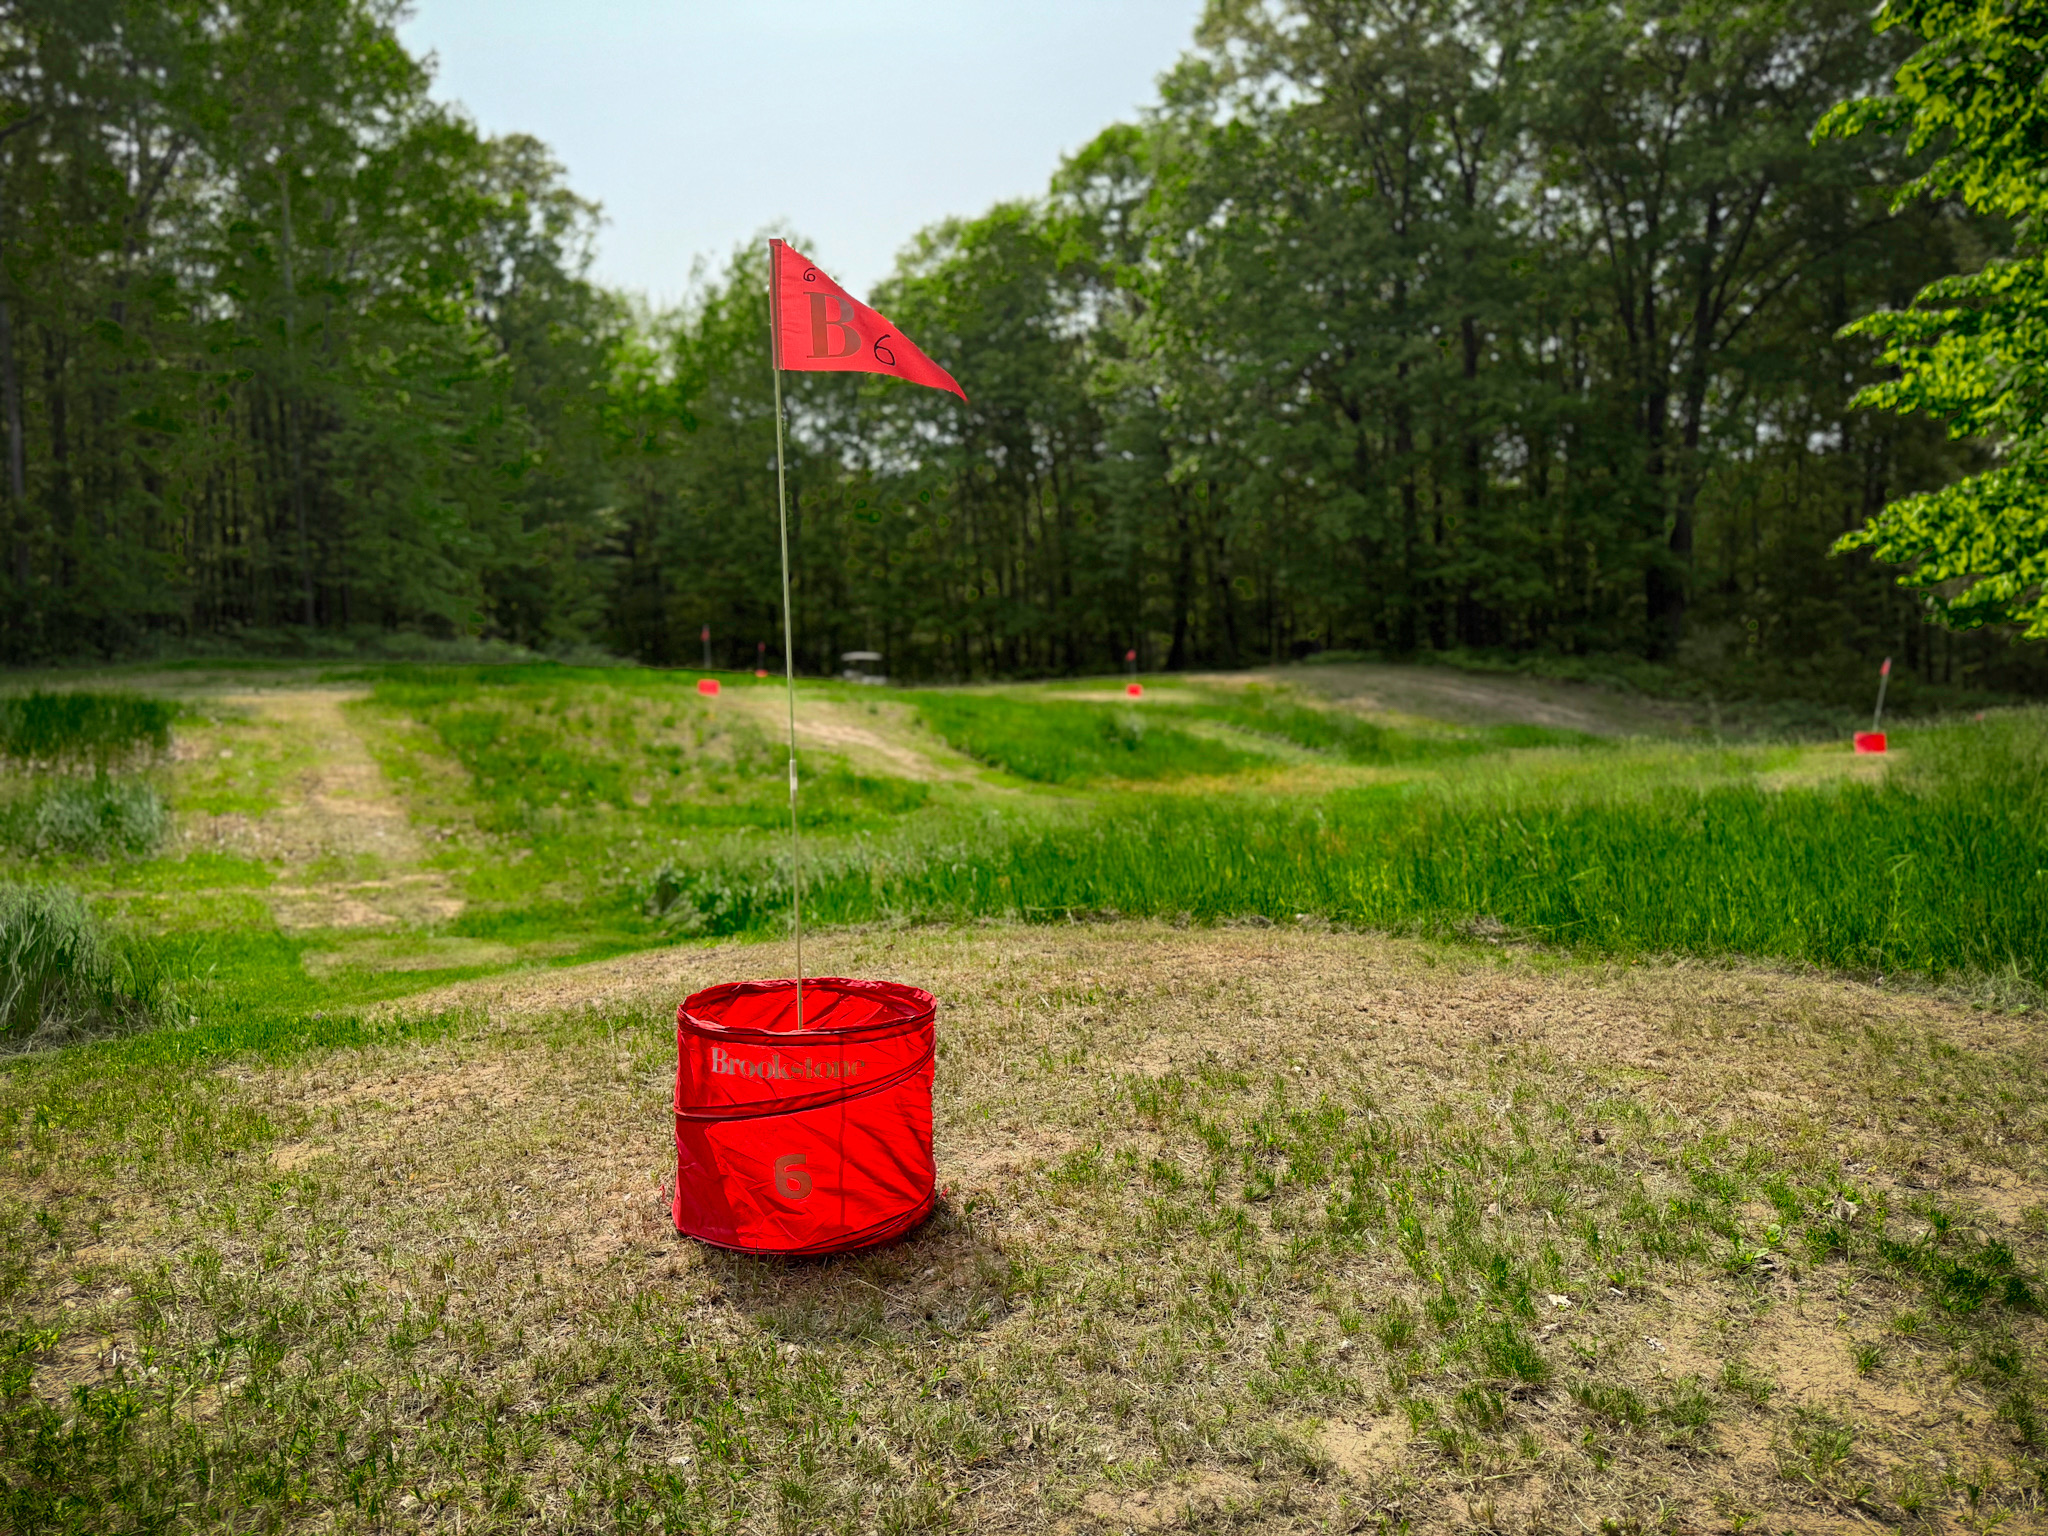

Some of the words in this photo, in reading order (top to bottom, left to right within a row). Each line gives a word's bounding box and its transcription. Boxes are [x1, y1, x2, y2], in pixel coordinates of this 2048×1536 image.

[804, 268, 816, 282] 6
[803, 292, 862, 359] B
[875, 335, 896, 366] 6
[711, 1047, 866, 1080] Brookstone
[774, 1153, 813, 1200] 6
